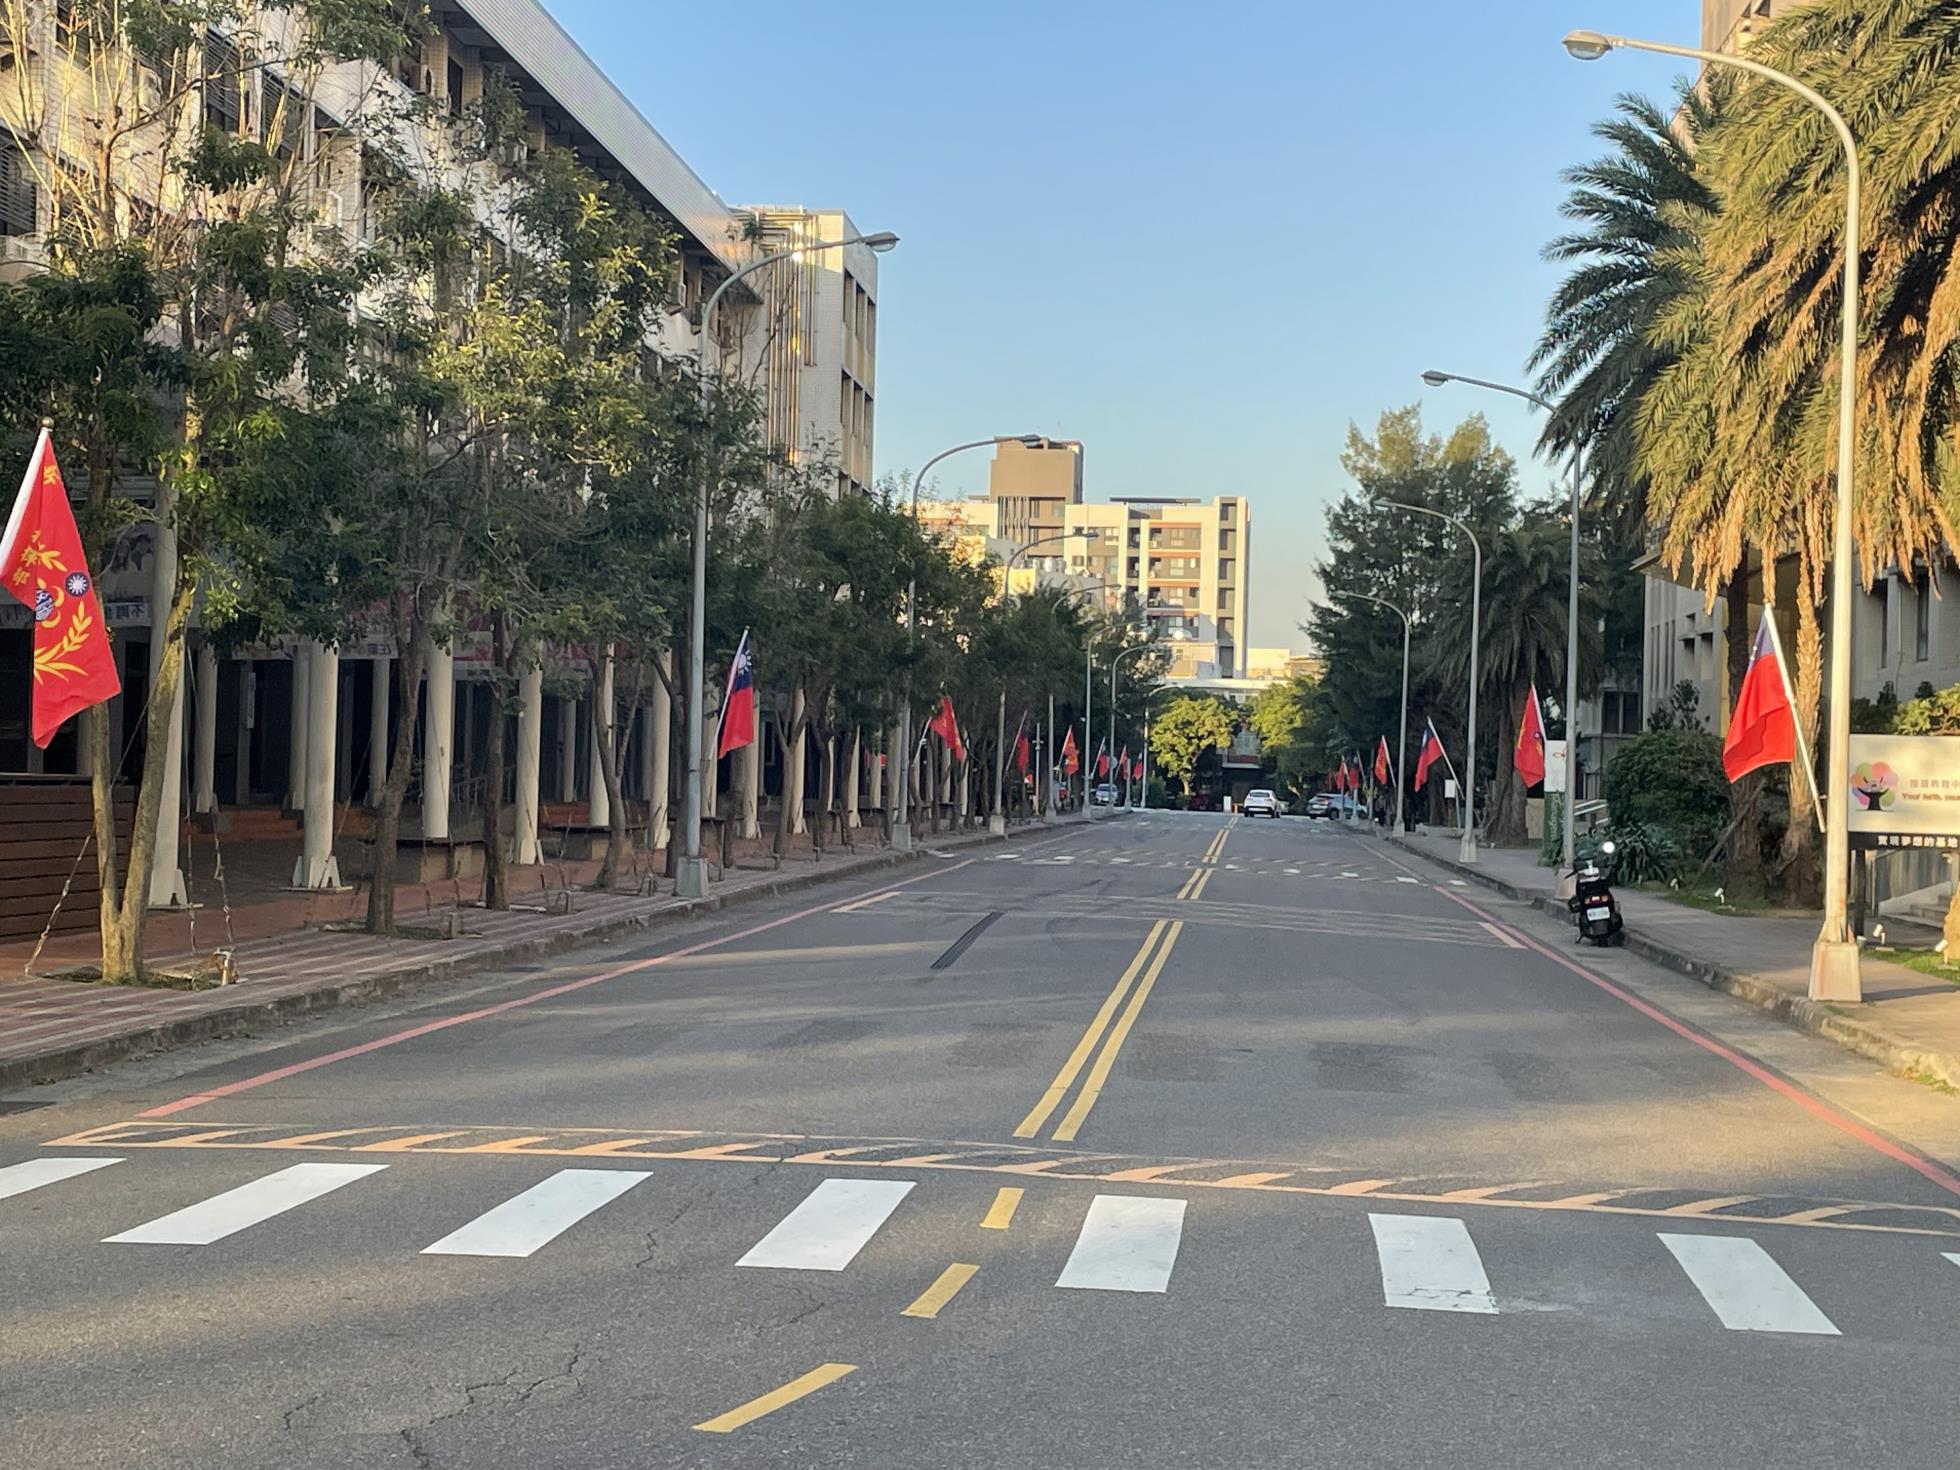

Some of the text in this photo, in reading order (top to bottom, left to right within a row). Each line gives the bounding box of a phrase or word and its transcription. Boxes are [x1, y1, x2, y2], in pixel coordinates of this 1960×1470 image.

[1878, 835, 1958, 848] 實現夢想的基地
